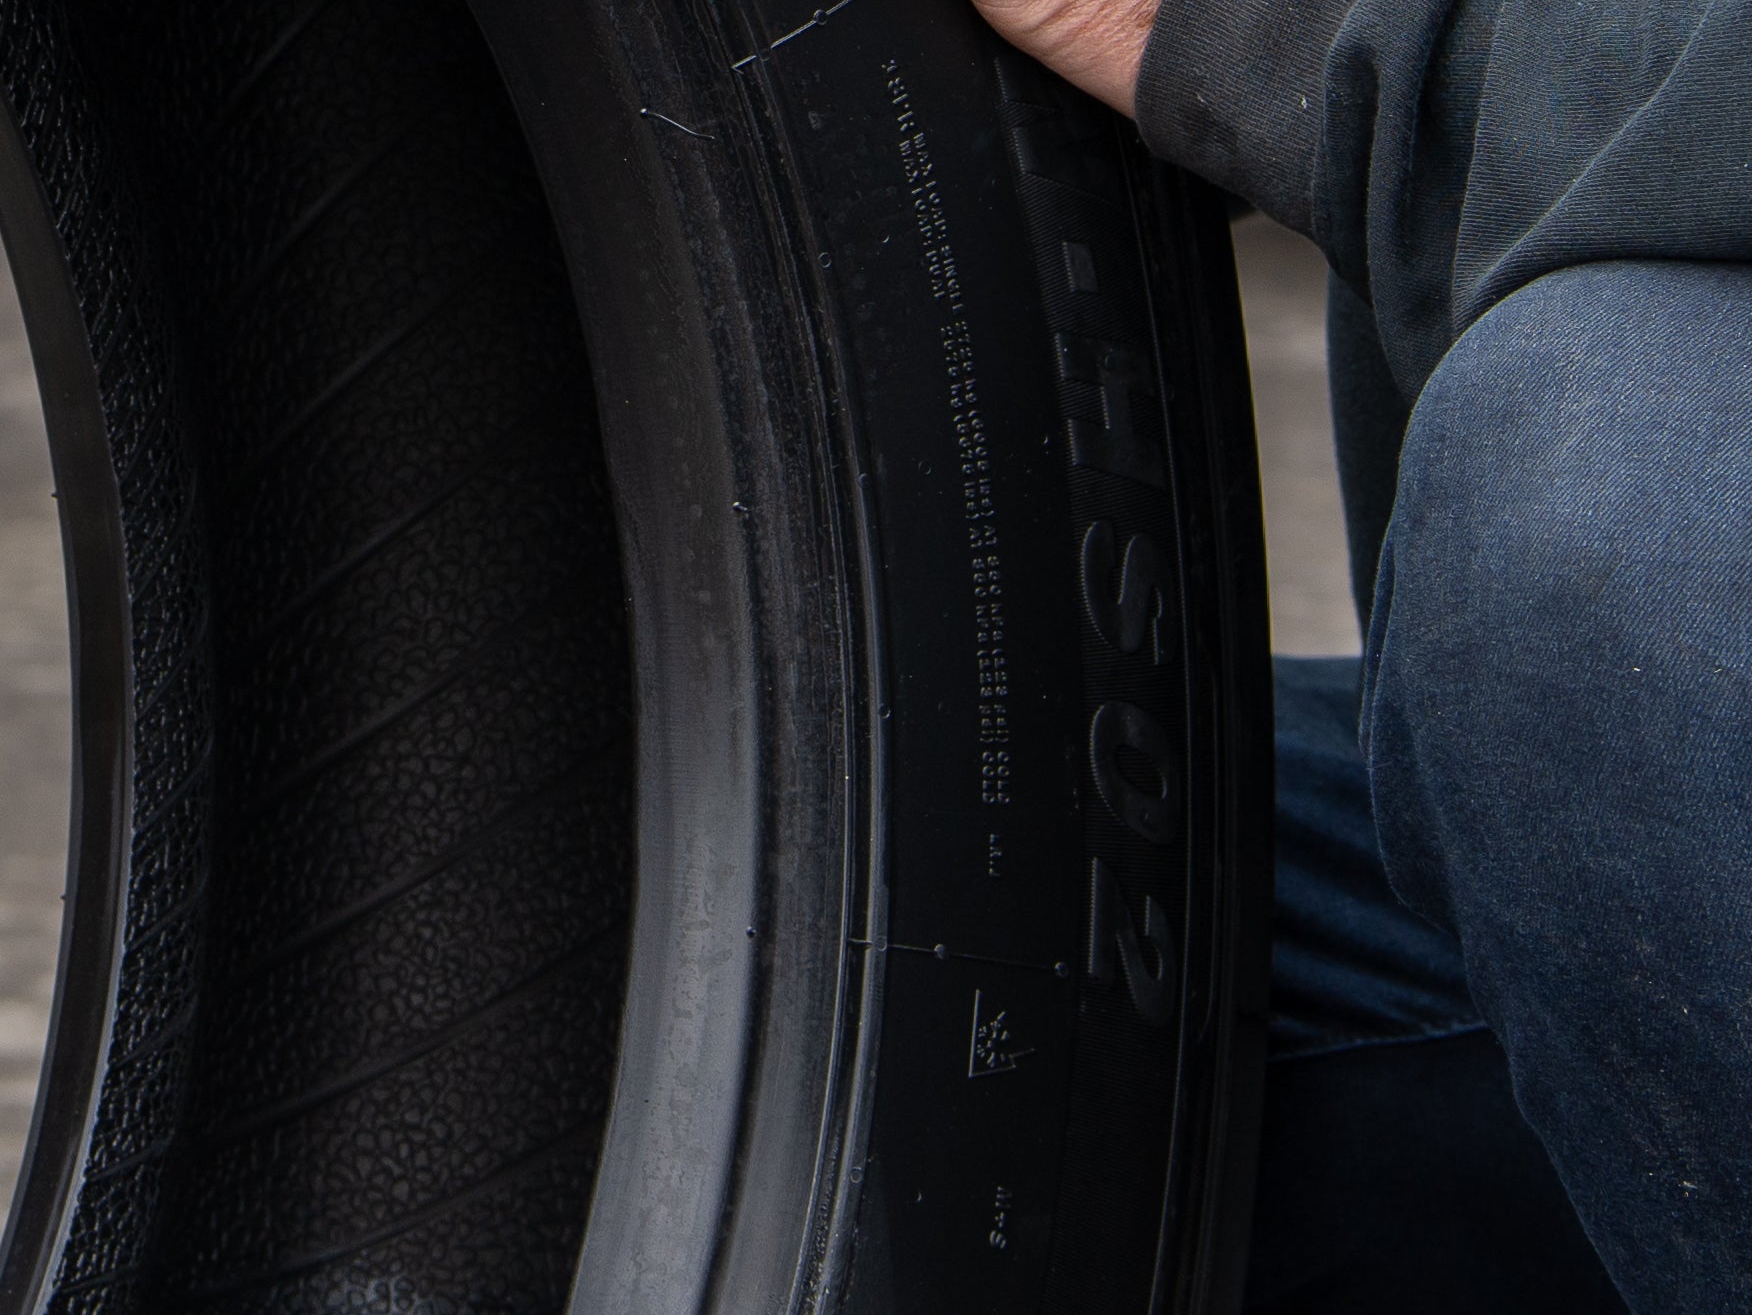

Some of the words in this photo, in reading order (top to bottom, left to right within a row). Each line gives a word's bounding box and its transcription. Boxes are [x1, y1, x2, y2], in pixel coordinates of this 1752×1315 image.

[968, 526, 983, 549] AT
[981, 750, 996, 804] COLD
[983, 524, 999, 548] AT
[996, 750, 1011, 804] COLD
[988, 1184, 1014, 1250] M+S
